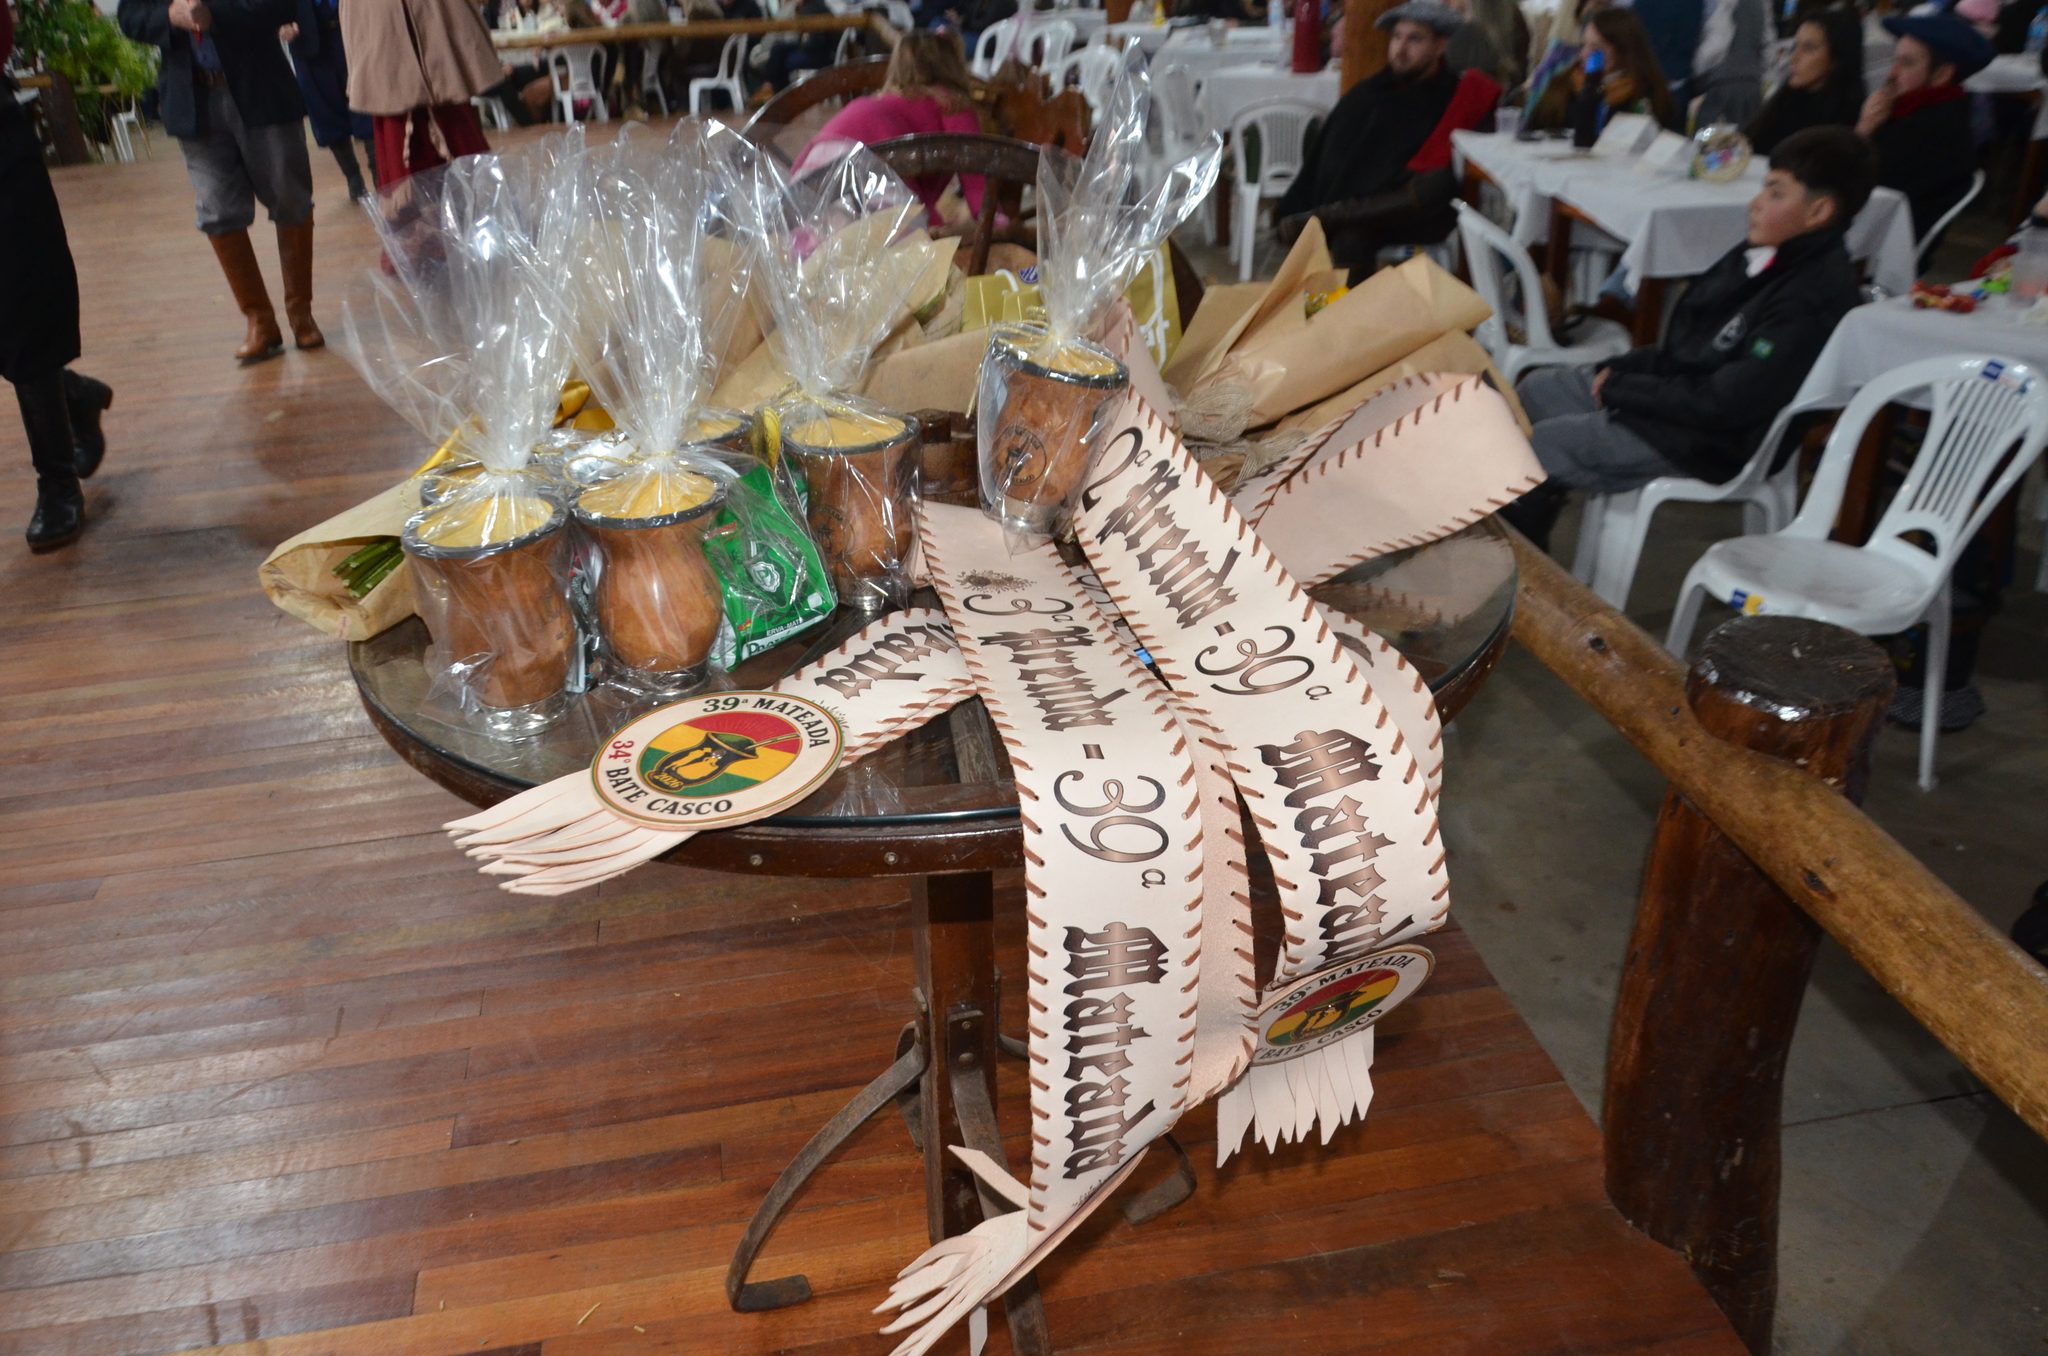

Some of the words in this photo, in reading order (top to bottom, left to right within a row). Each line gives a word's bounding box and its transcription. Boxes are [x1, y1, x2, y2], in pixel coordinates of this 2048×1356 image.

[814, 622, 960, 700] eada
[751, 697, 831, 749] MATEADA
[606, 767, 646, 804] BATE
[647, 799, 733, 816] CASCO
[655, 772, 683, 788] 2026
[1254, 729, 1415, 970] Matead
[1319, 955, 1417, 987] MATEADA
[1062, 921, 1170, 1179] Mateada
[1259, 1042, 1306, 1060] BATE
[1317, 1009, 1383, 1045] CASCO
